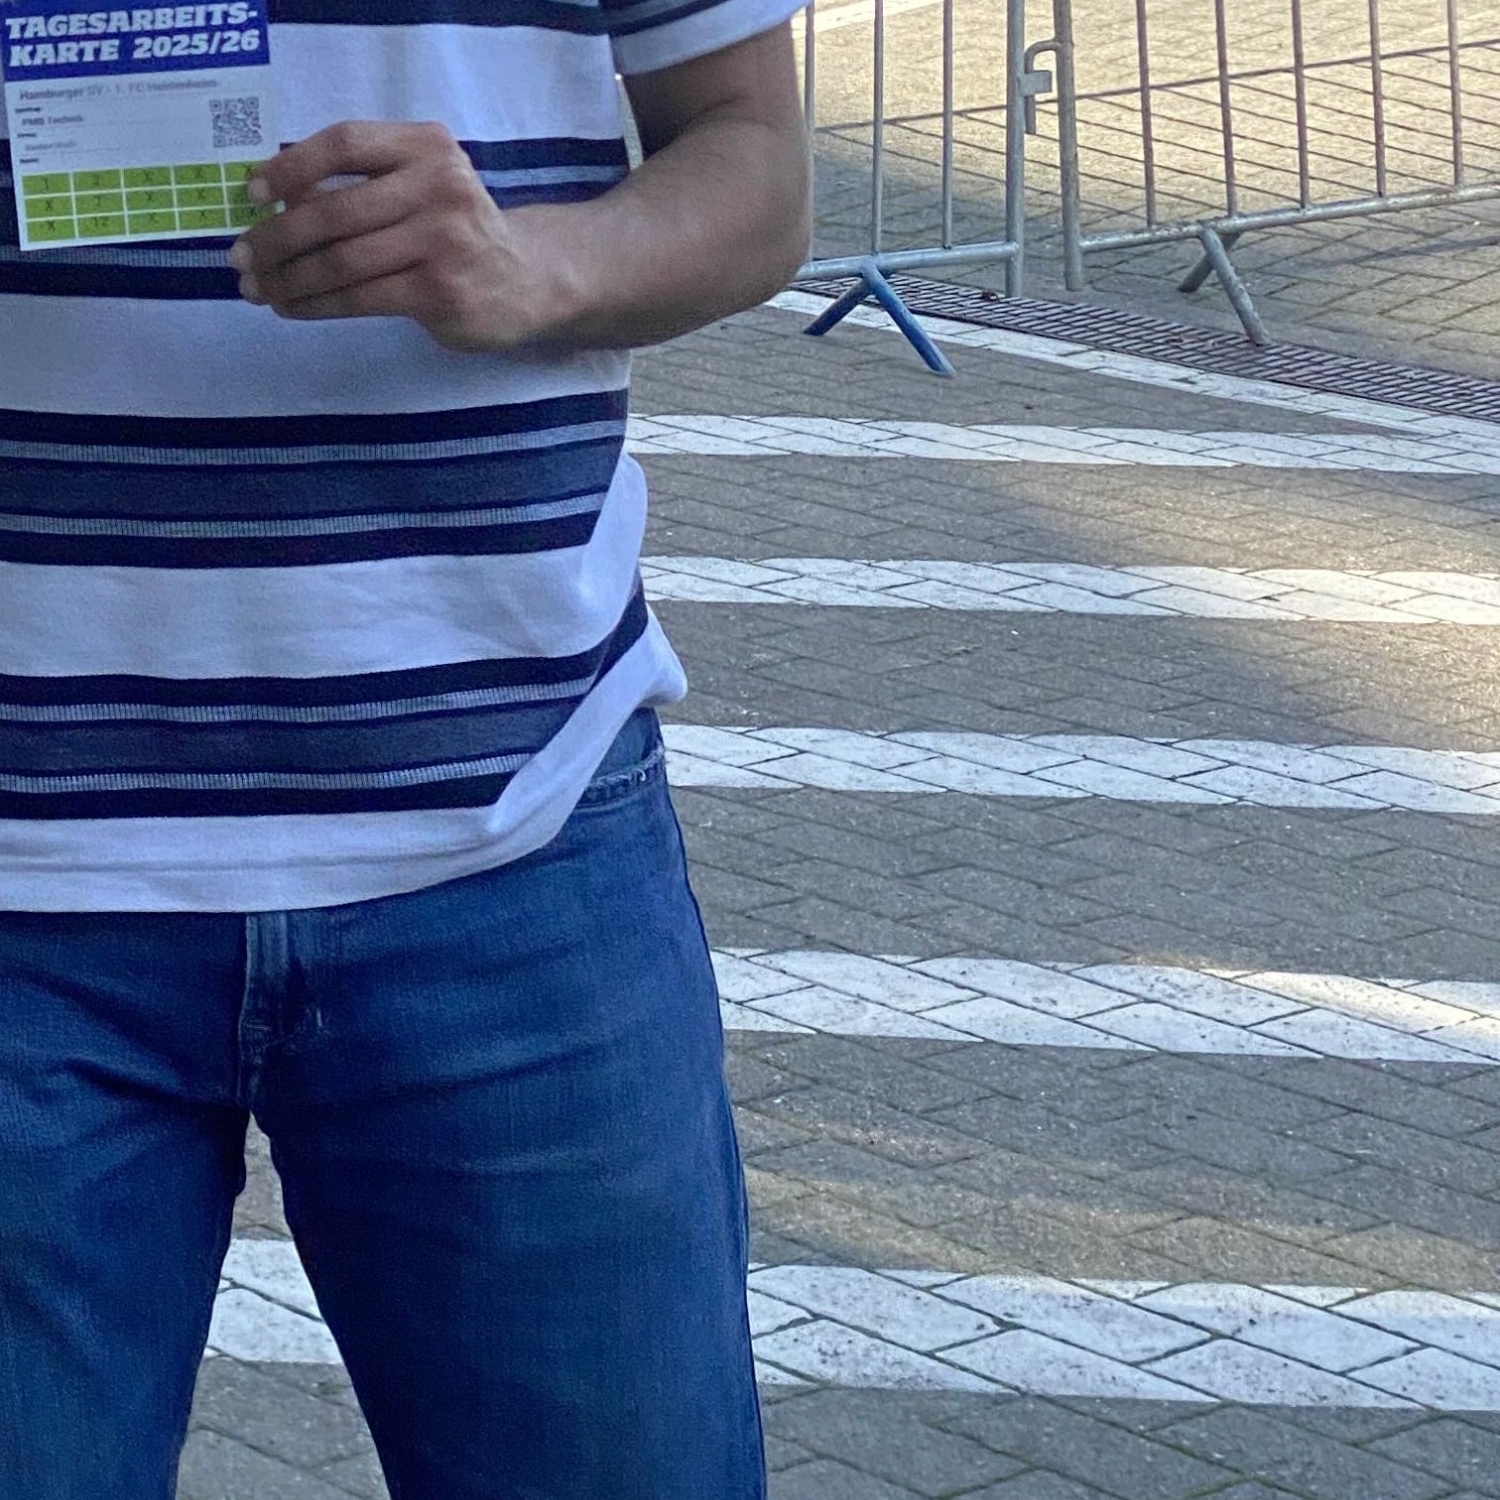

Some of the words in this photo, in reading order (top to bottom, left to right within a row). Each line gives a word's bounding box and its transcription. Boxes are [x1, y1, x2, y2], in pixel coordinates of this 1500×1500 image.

[5, 2, 258, 40] TAGESARBEITS-
[9, 39, 120, 67] KARTE
[133, 29, 260, 59] 2025/26
